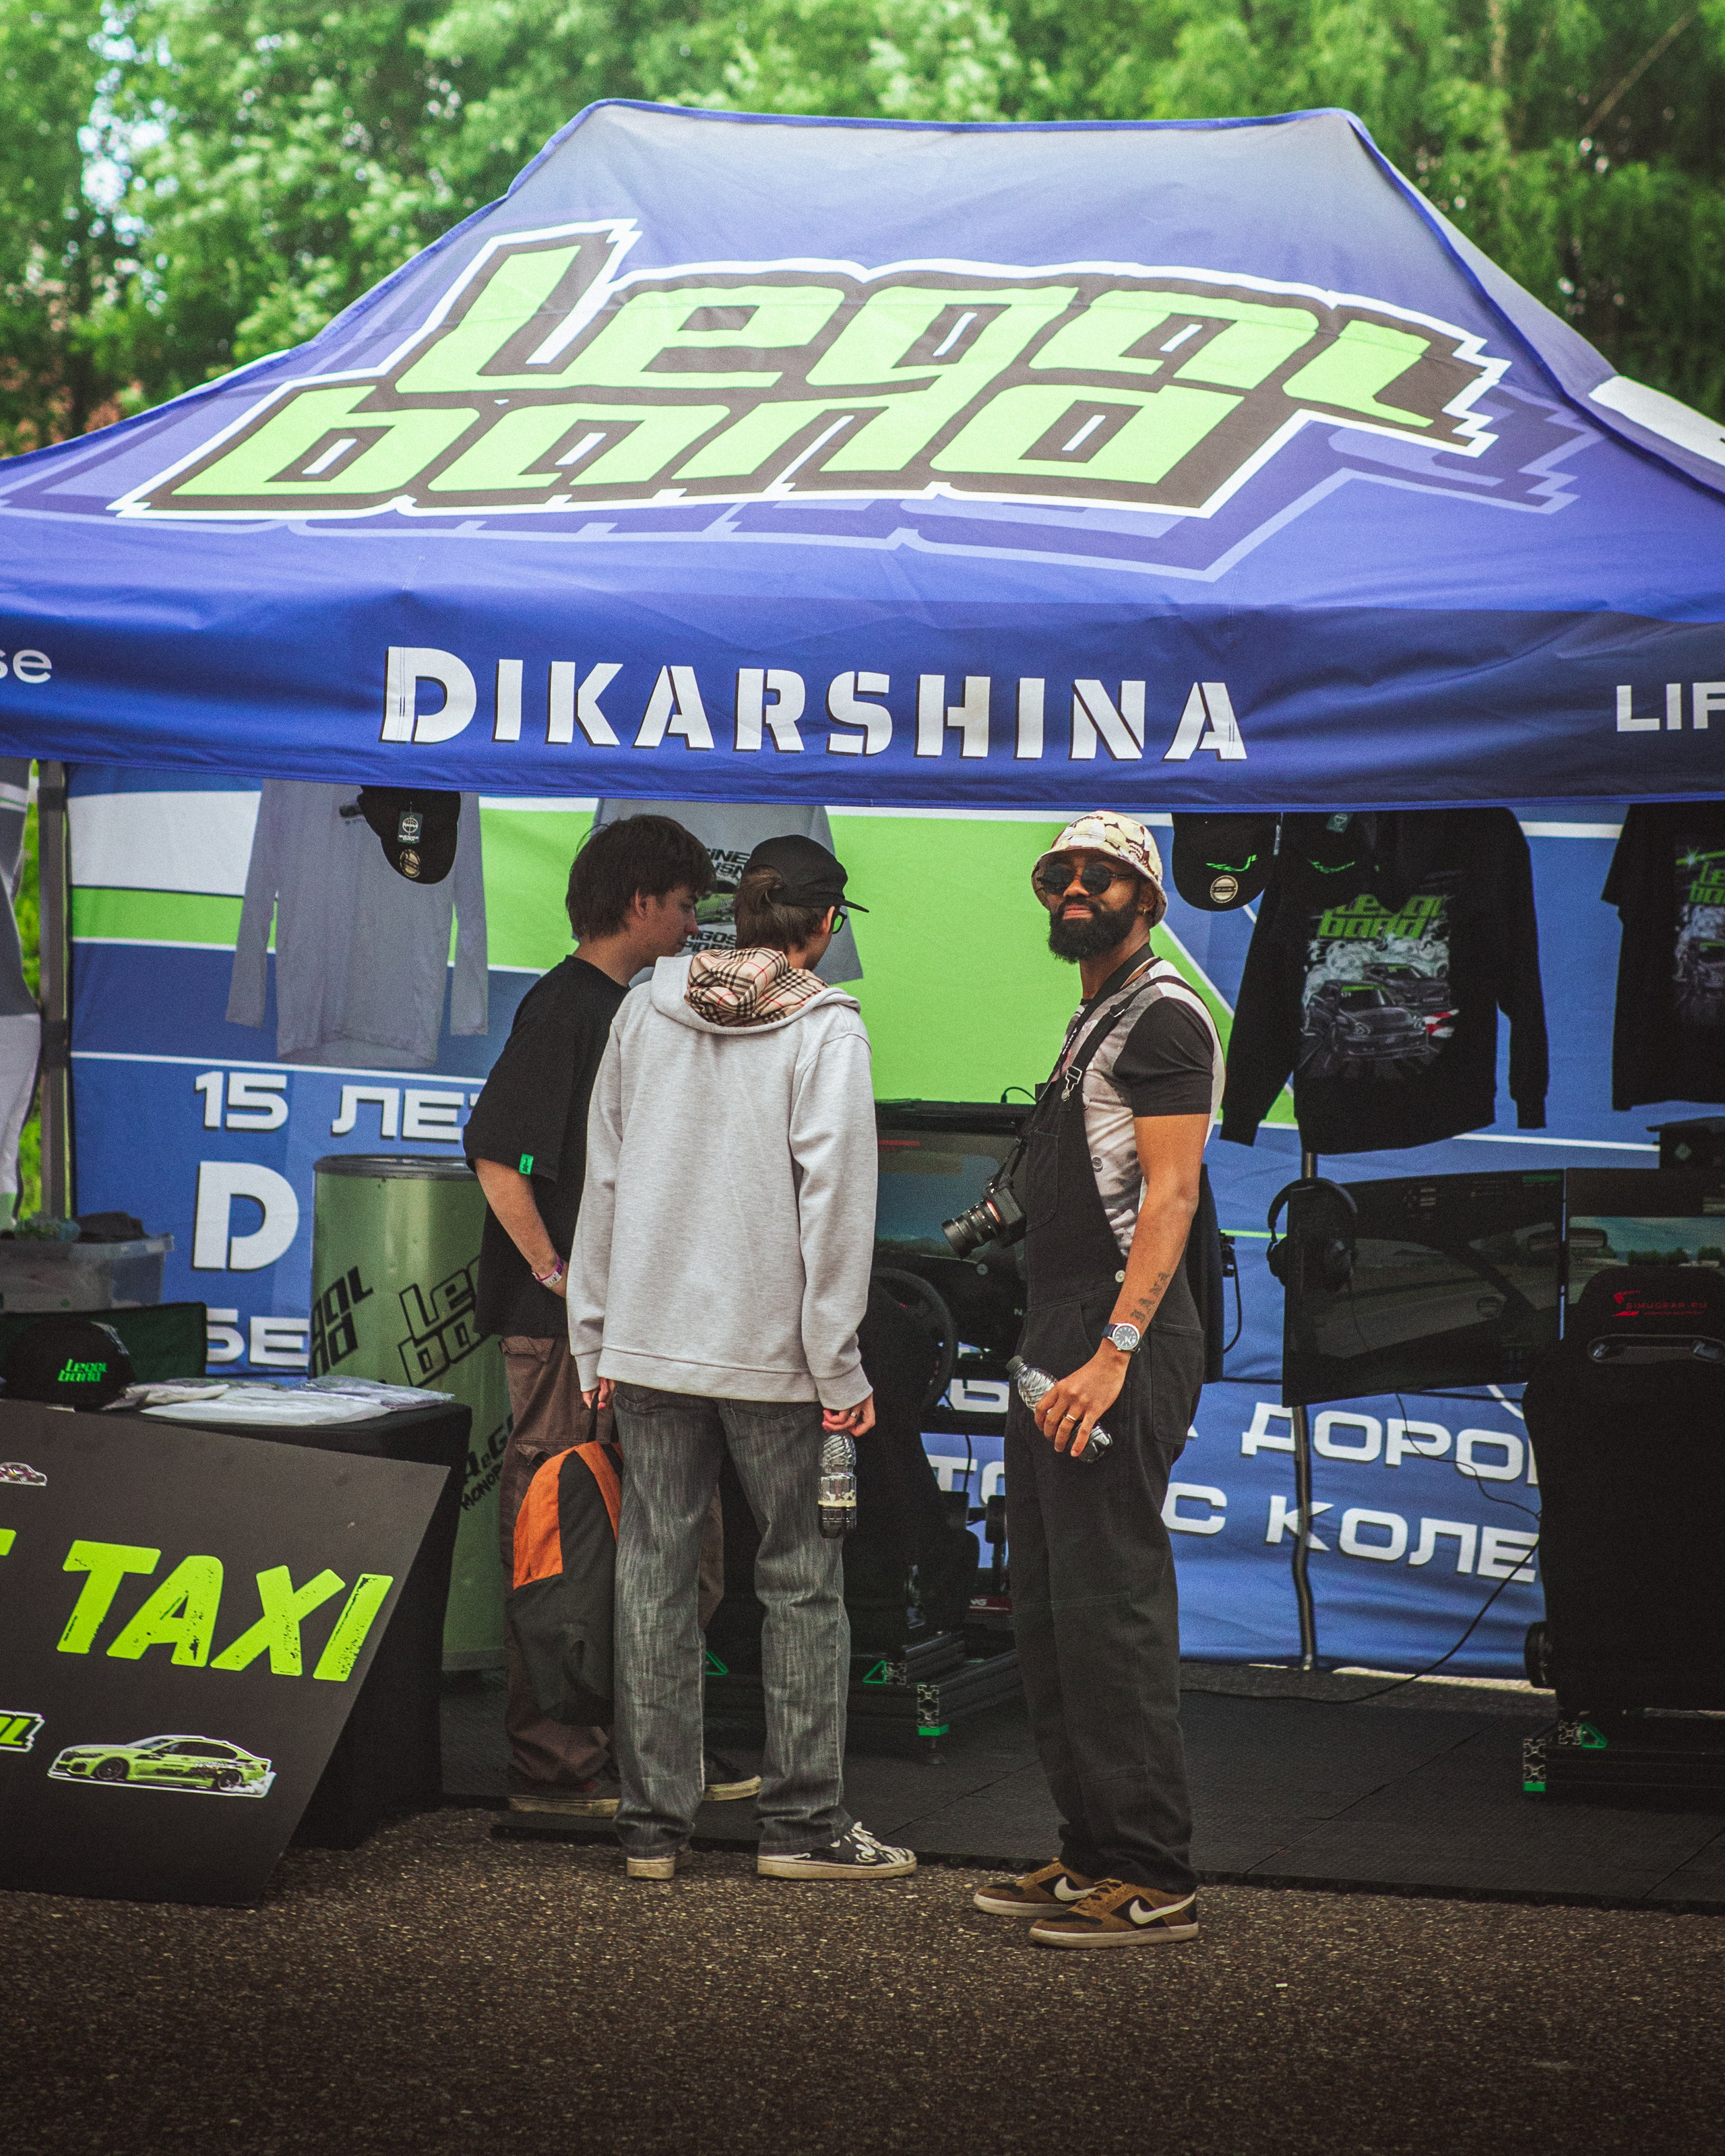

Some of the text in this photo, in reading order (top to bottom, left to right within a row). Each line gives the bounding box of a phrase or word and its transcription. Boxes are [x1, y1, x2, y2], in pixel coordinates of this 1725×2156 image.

[379, 645, 1249, 761] DIKARSHINA
[194, 1071, 480, 1142] 15 ЛЕ
[193, 1160, 300, 1271] D
[1241, 1401, 1538, 1484] ДОРО
[1265, 1494, 1539, 1583] КОЛЕ
[56, 1539, 394, 1682] TAXI
